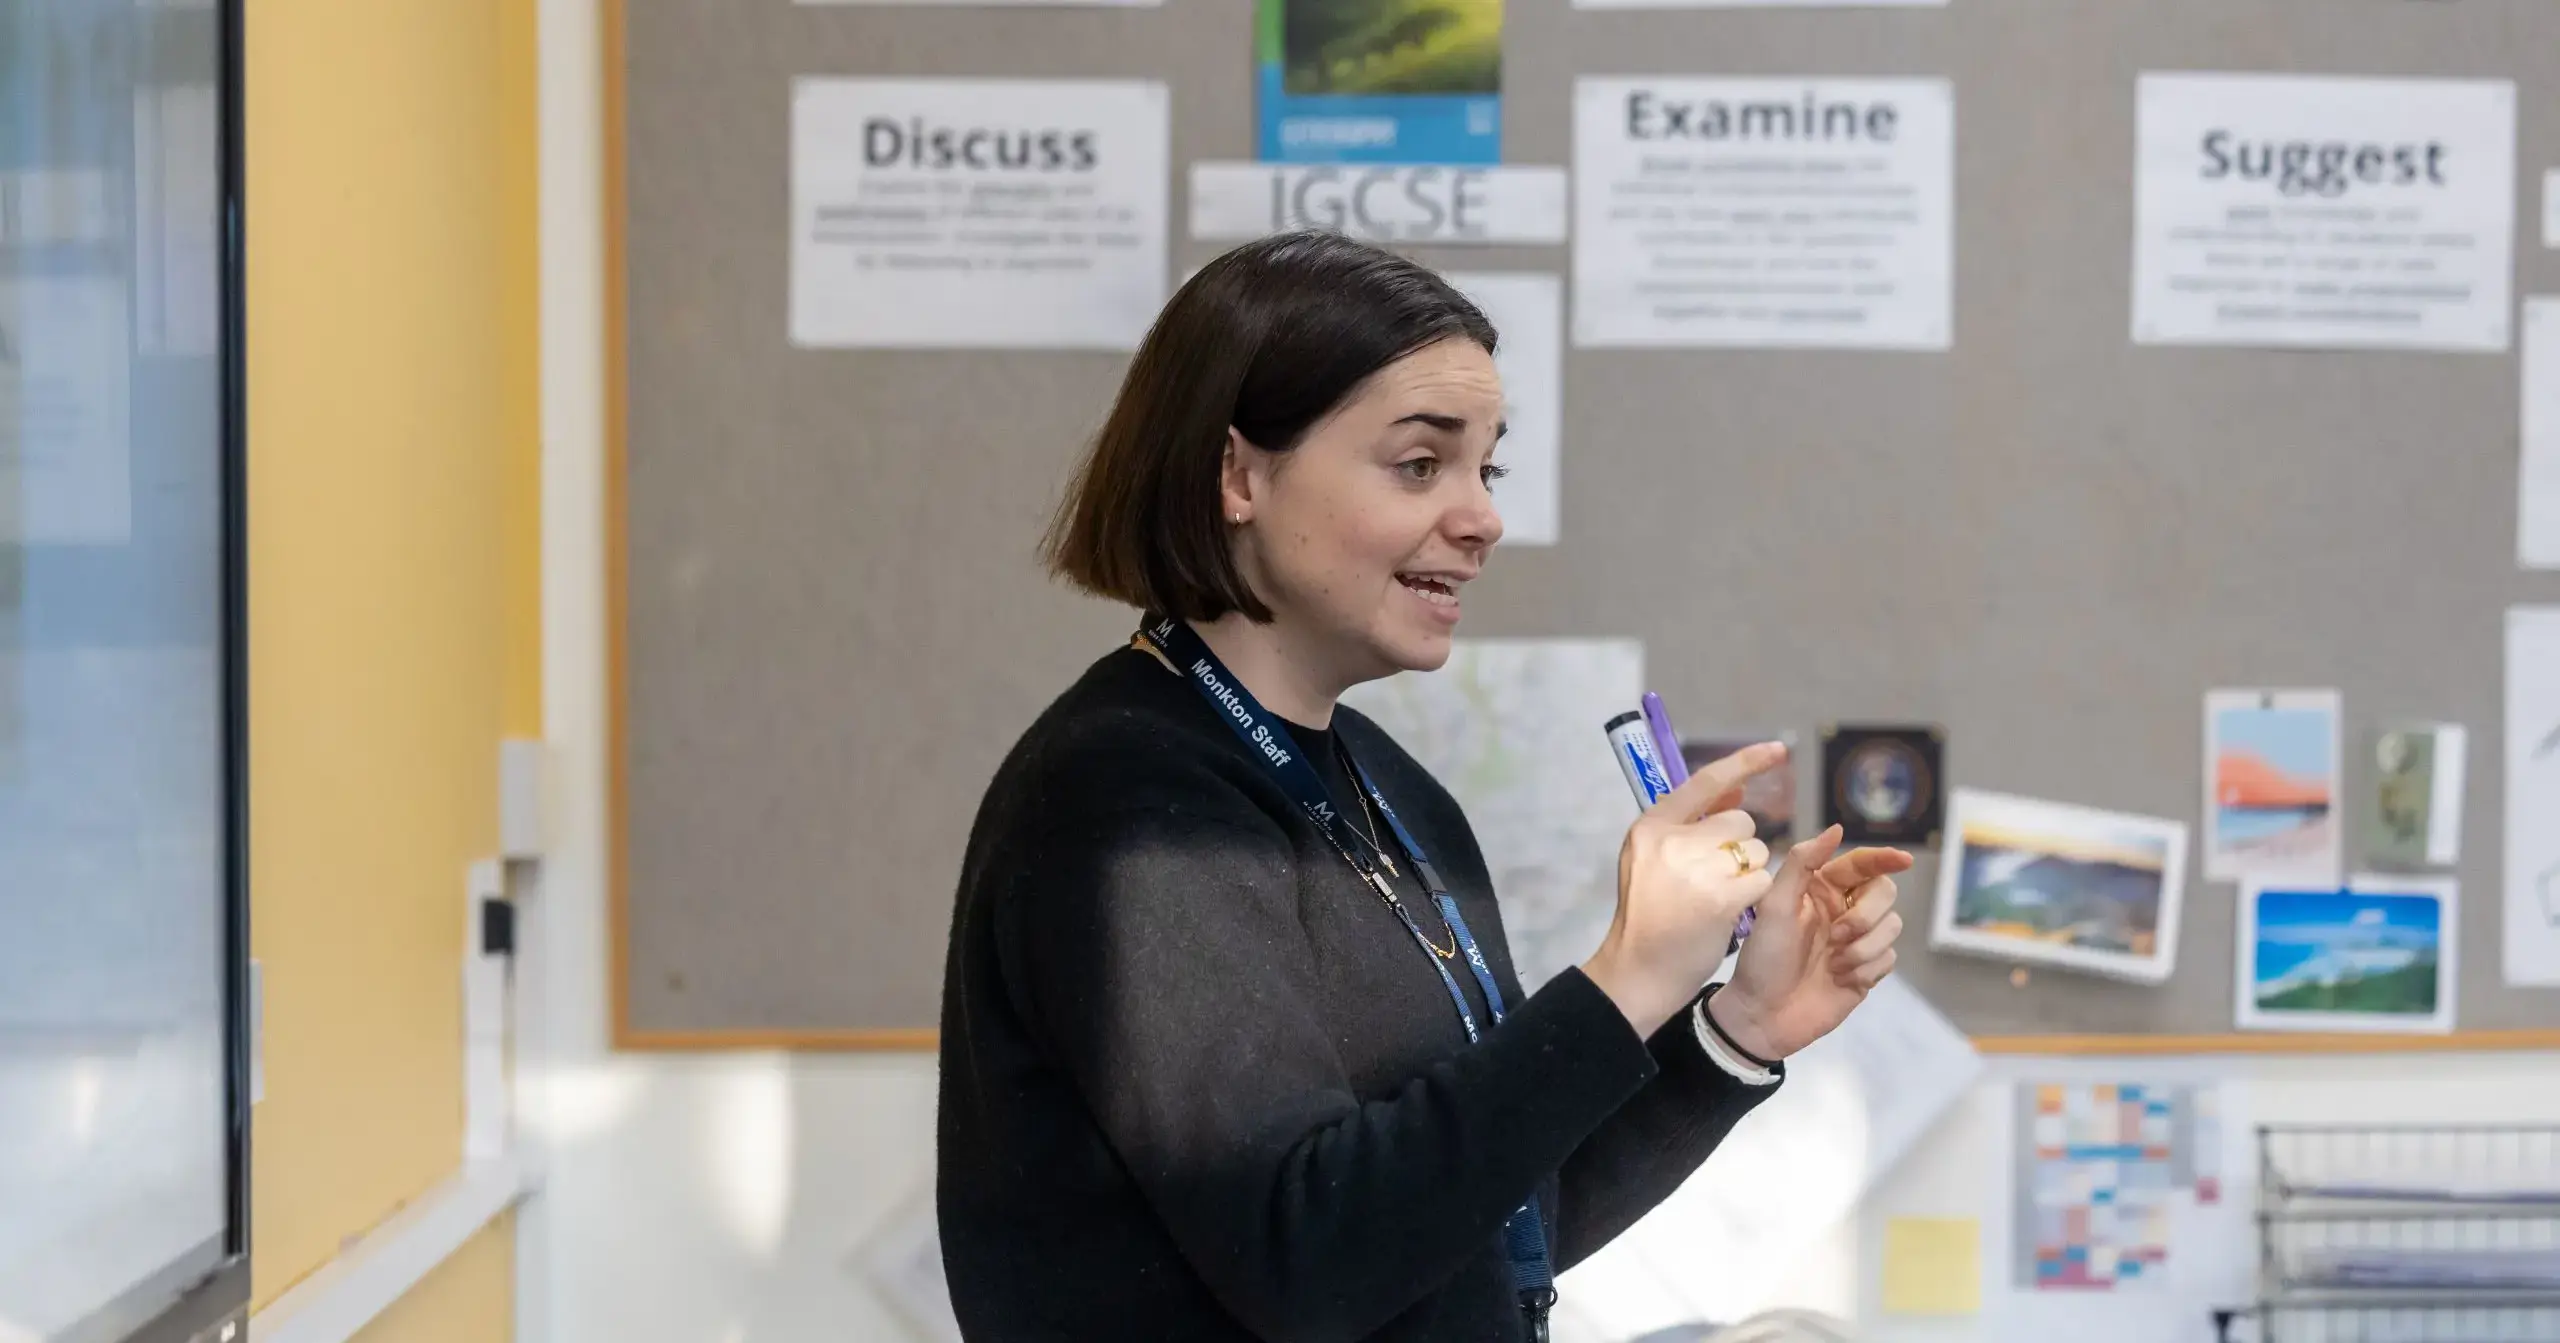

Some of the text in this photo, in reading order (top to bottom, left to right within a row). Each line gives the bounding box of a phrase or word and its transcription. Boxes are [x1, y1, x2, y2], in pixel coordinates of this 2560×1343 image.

[863, 115, 1100, 173] Discuss
[1624, 89, 1898, 143] Examine
[2199, 130, 2446, 198] Suggest
[1272, 166, 1487, 238] IGCSE
[1156, 618, 1175, 638] M
[1191, 658, 1292, 767] Monkton Staff
[1314, 801, 1335, 821] M
